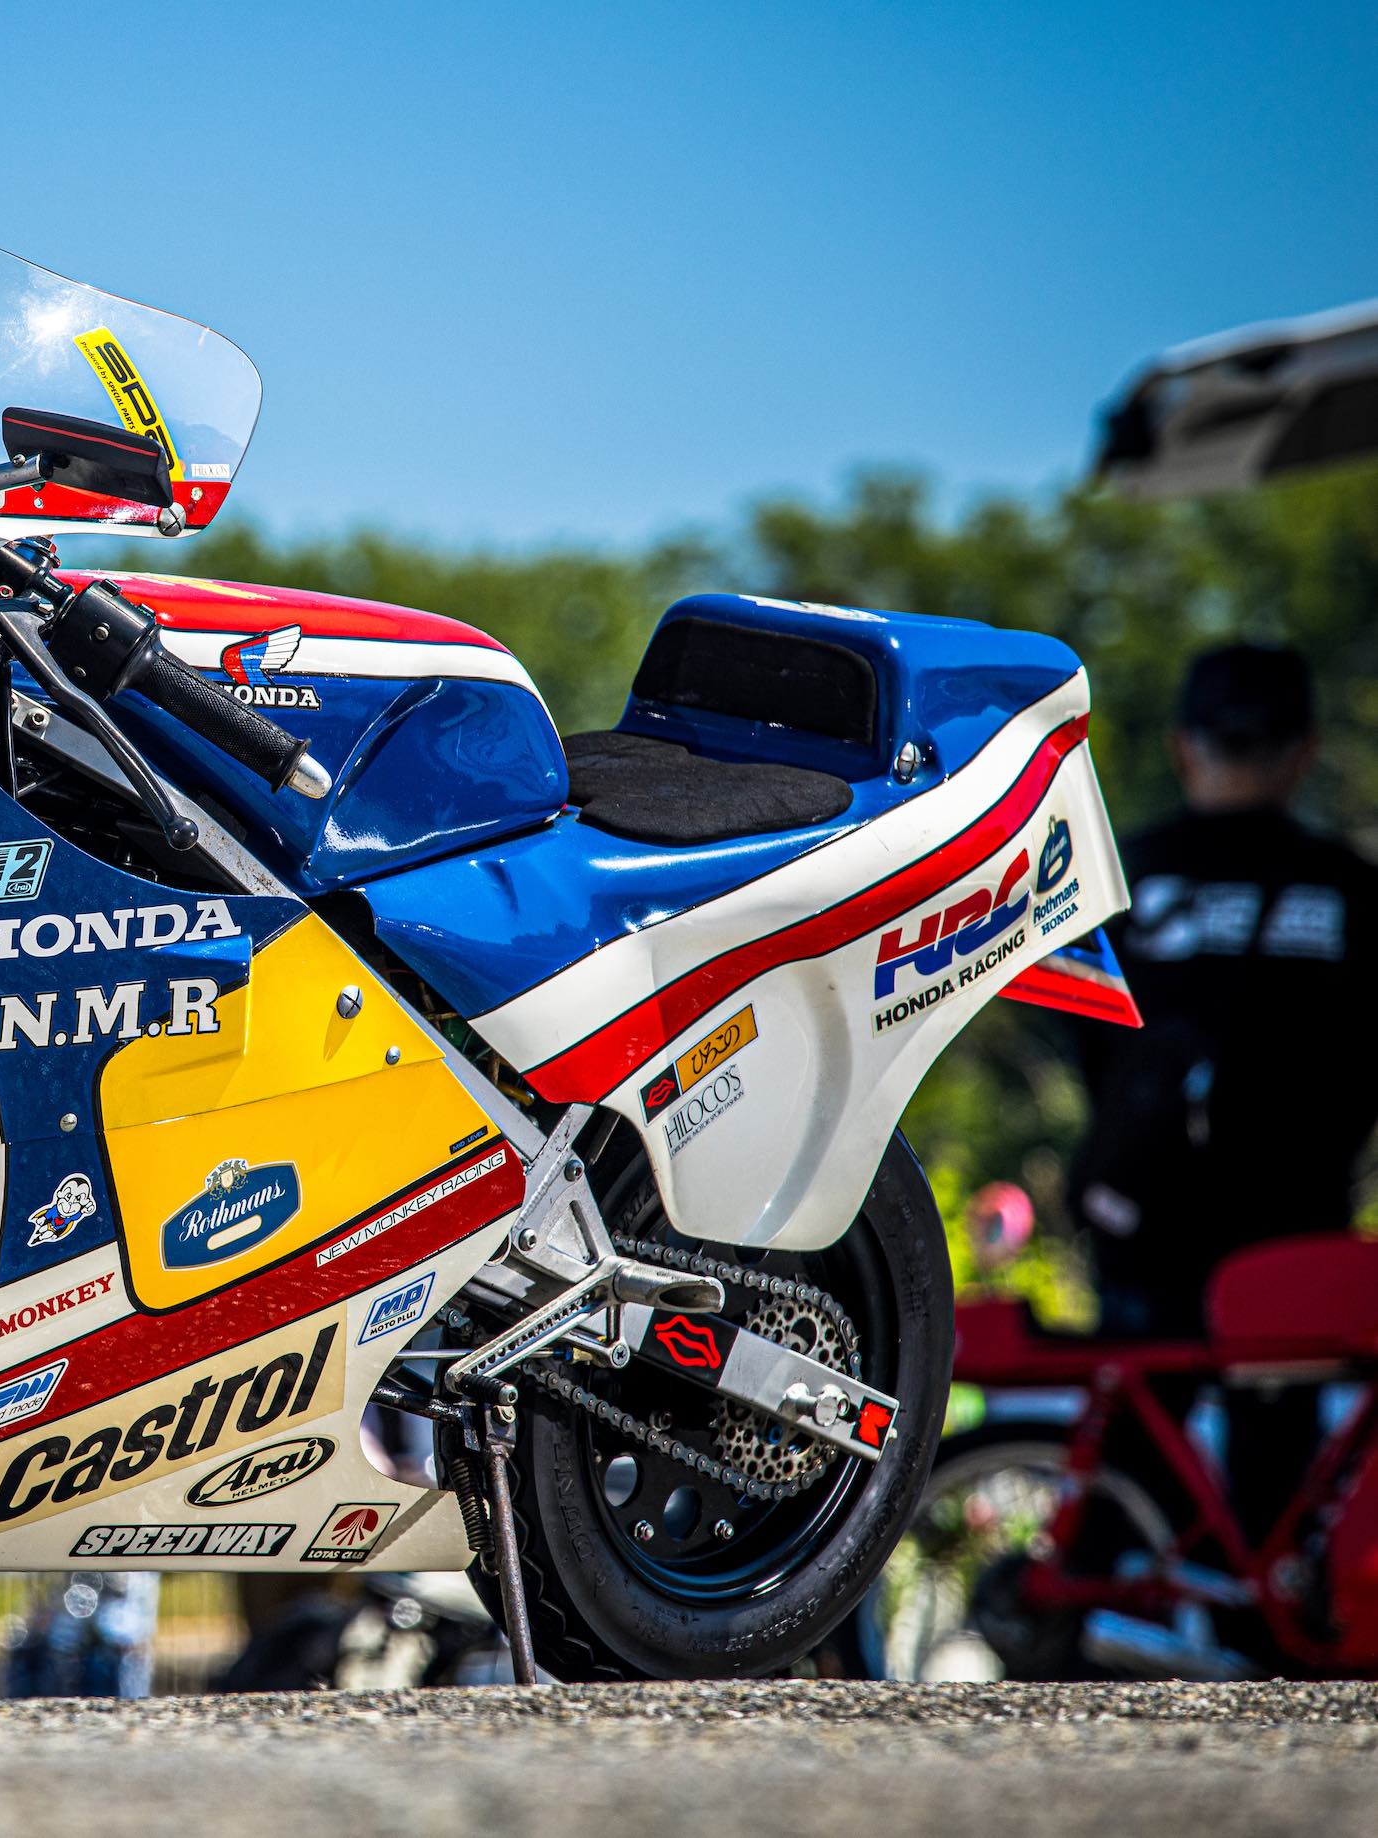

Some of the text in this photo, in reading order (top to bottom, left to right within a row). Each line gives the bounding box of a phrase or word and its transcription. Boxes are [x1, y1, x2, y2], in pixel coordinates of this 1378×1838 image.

[81, 341, 135, 430] Produced by SPECIAL PARTS
[10, 846, 43, 880] 2
[874, 848, 1030, 1000] HRC
[1033, 878, 1080, 924] Rothmans
[1041, 902, 1079, 936] HONDA
[876, 929, 1026, 1031] HONDA RACING
[664, 1063, 741, 1148] HILOCO'S
[179, 1179, 285, 1242] Rothmans
[318, 1152, 504, 1265] NEW MONKEY RACING
[370, 1284, 426, 1328] MP
[370, 1319, 396, 1336] MOTO
[9, 1397, 43, 1416] mode
[195, 1438, 318, 1503] Arai
[307, 1550, 340, 1559] LOTAS
